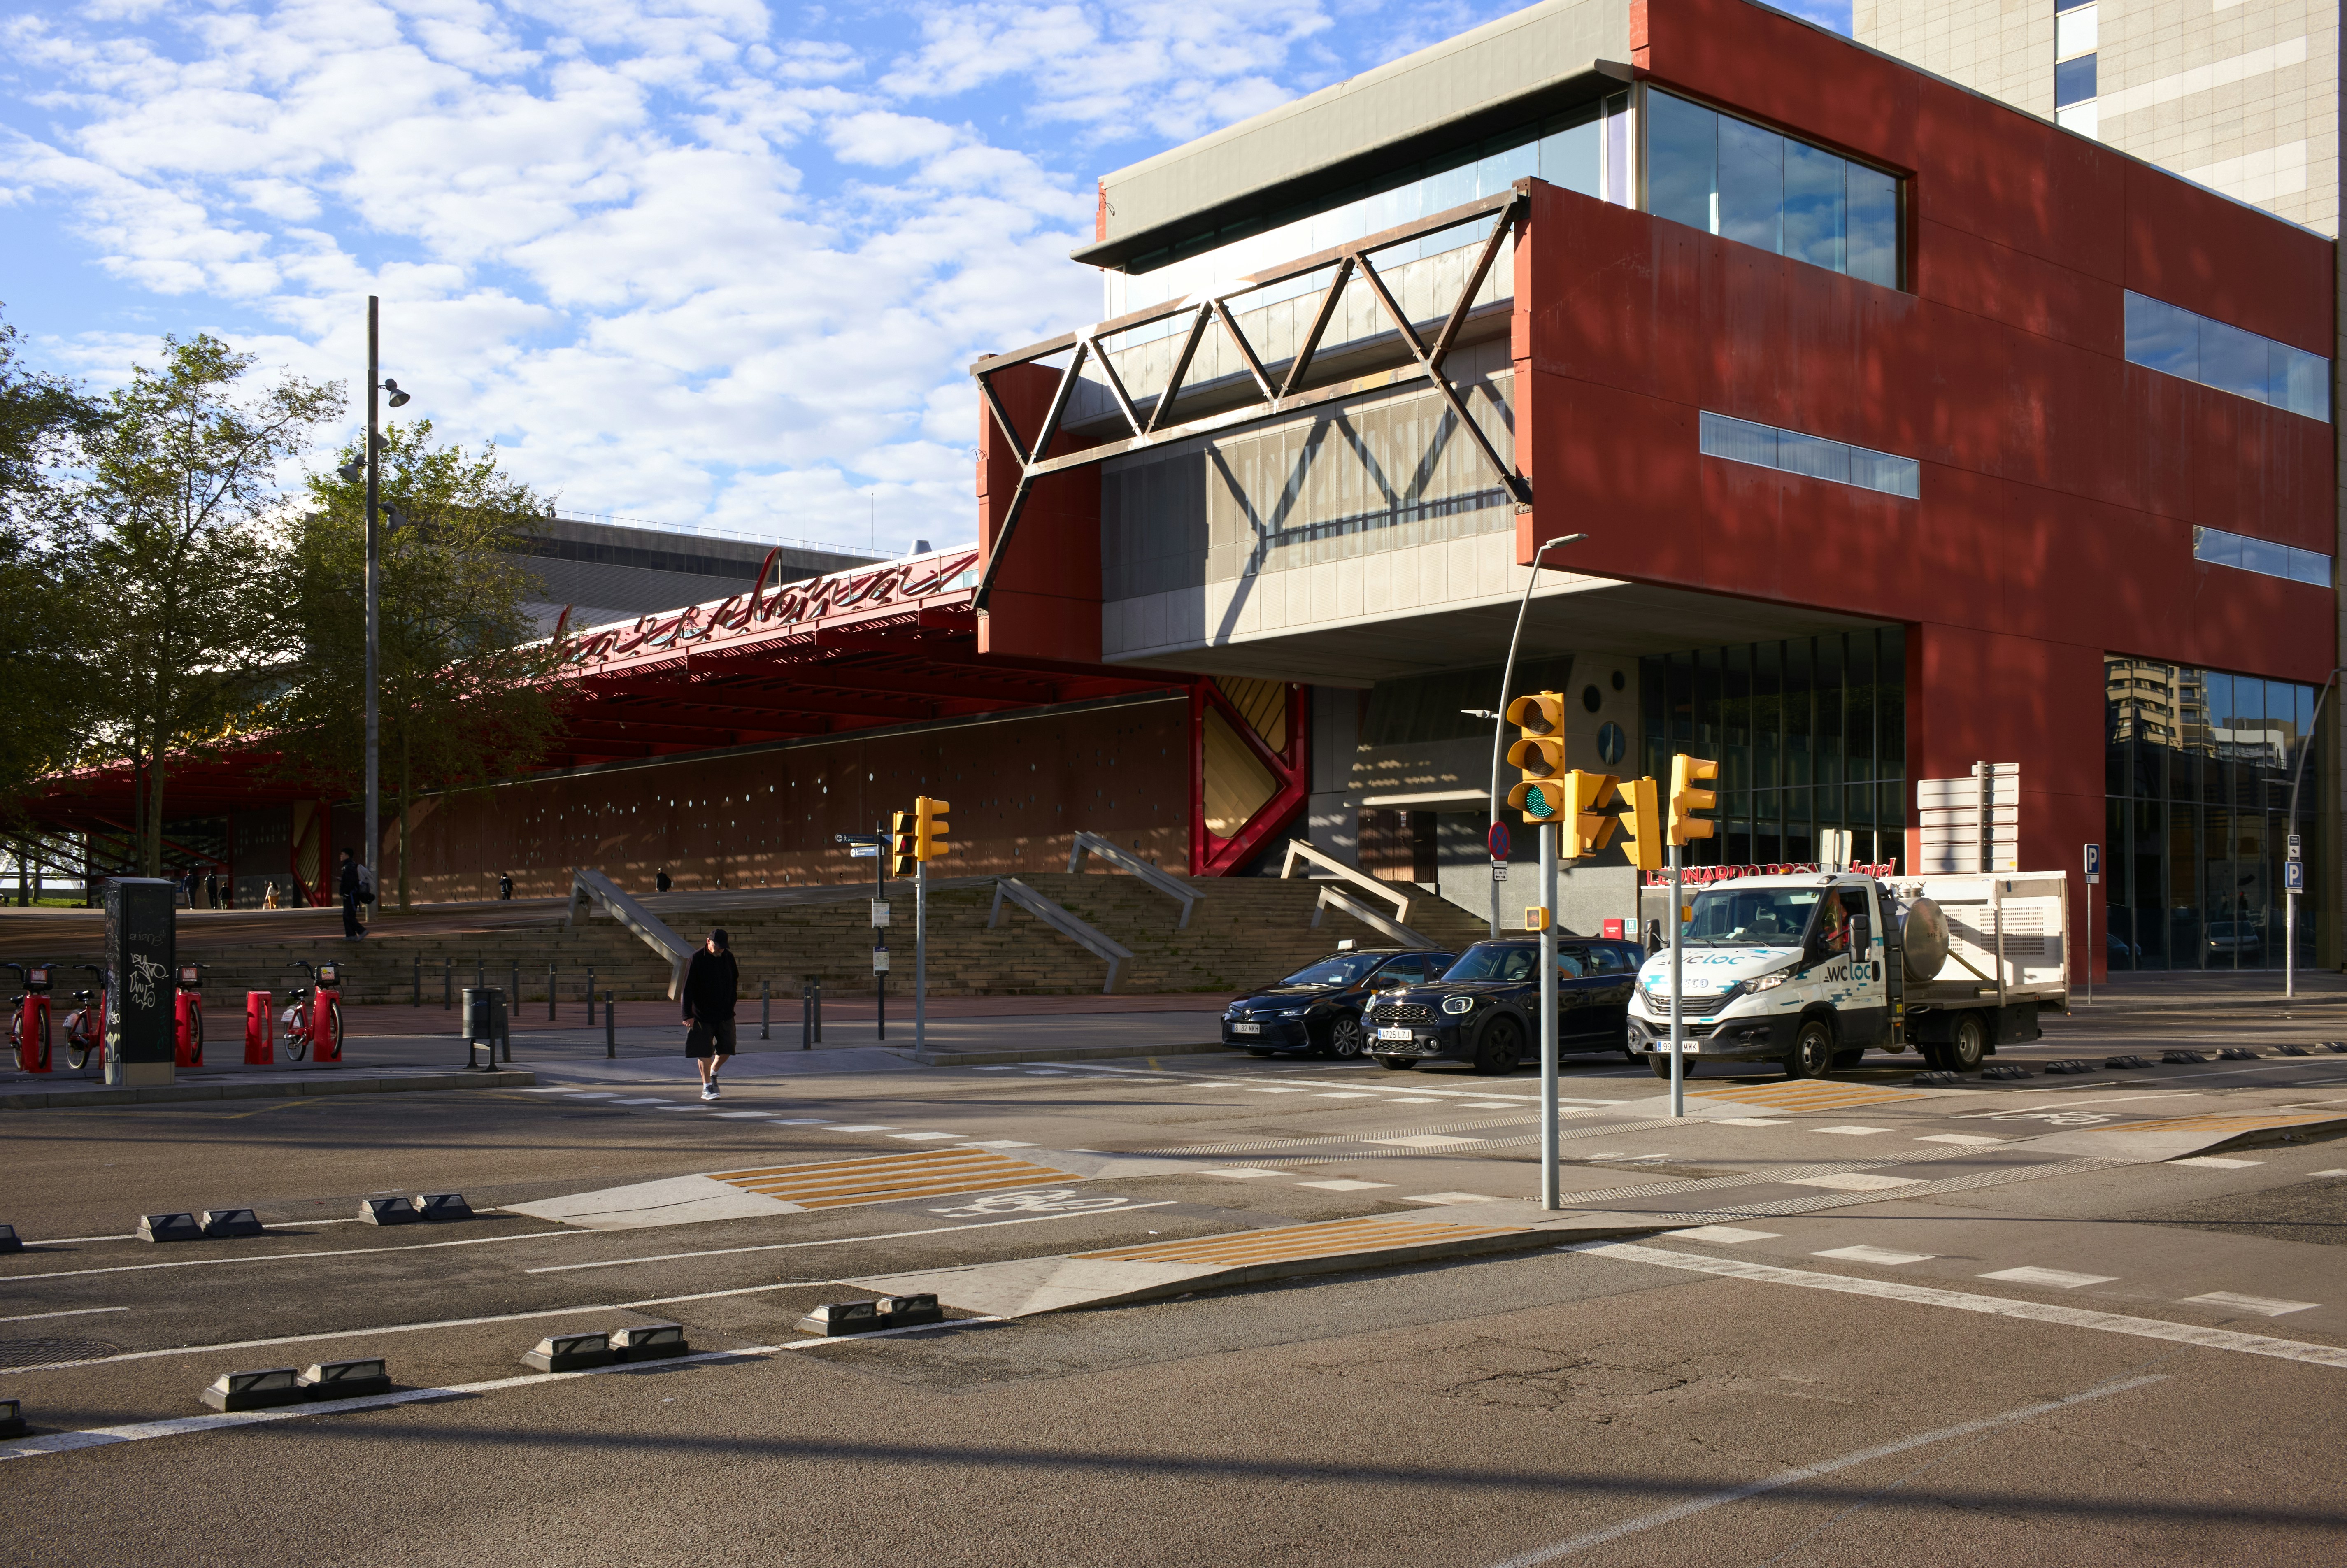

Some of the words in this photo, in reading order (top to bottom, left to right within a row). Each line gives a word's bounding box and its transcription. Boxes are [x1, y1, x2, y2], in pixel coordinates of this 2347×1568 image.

[2089, 848, 2097, 870] P
[1647, 864, 1761, 885] LENARDO
[2289, 865, 2299, 885] P
